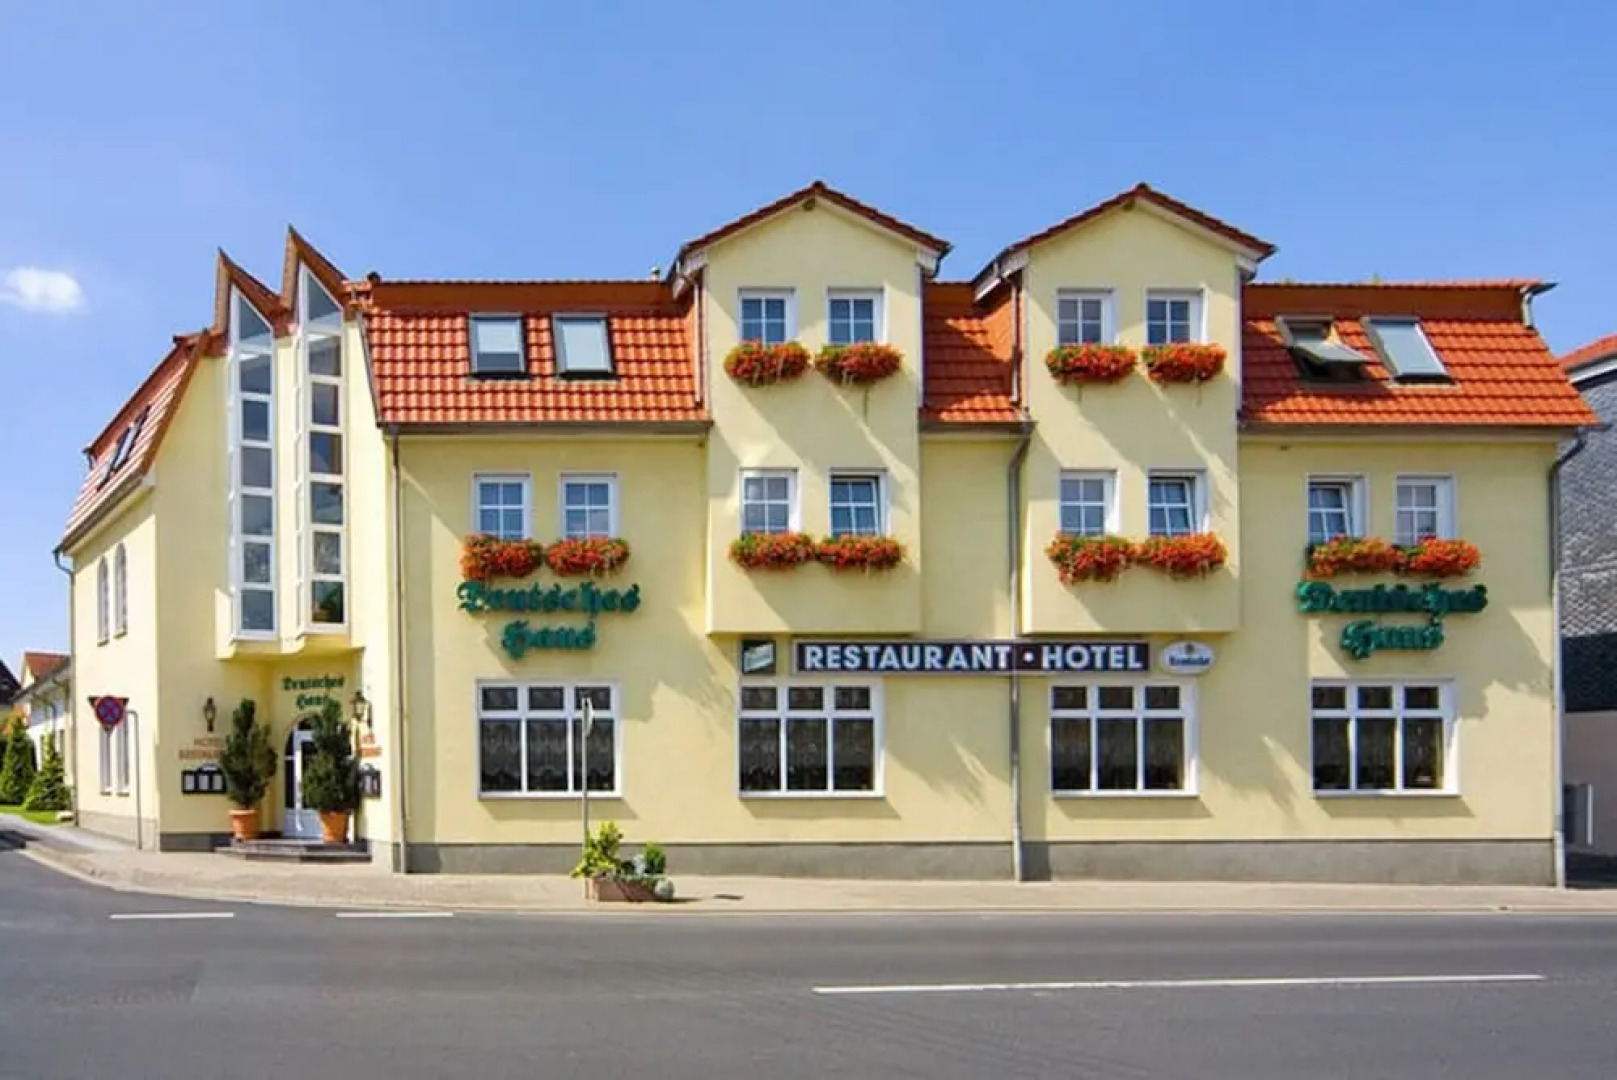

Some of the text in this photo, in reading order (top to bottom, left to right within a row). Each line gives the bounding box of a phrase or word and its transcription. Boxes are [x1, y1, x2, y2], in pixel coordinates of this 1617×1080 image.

[457, 581, 641, 615] Deutsches
[1296, 581, 1488, 616] Deutsches
[502, 619, 596, 660] Haus
[804, 645, 1011, 669] RESTAURANT
[1041, 645, 1143, 669] HOTEL
[1341, 619, 1445, 660] Haus
